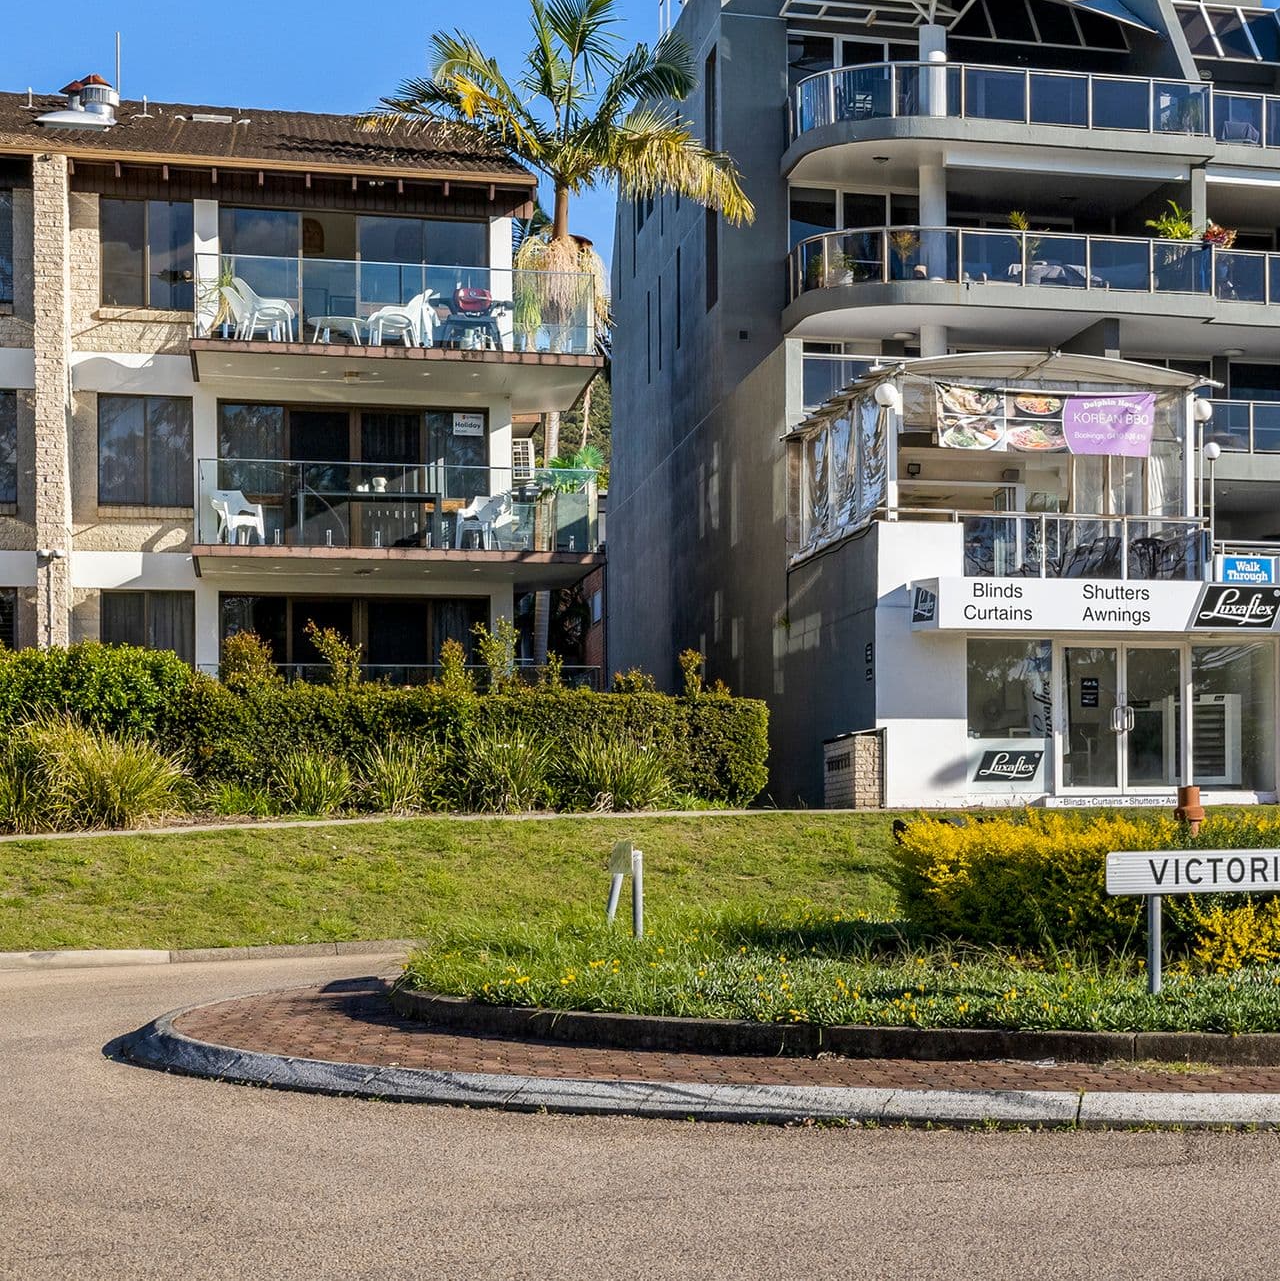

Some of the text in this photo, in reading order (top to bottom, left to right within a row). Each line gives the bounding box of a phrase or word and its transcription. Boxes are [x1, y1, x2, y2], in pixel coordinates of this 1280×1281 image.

[1073, 412, 1122, 424] KOREAN
[1235, 561, 1261, 572] Walk
[1227, 570, 1268, 583] Through
[972, 583, 1023, 599] Blinds
[1082, 585, 1150, 601] Shutters
[963, 604, 1033, 621] Curtains
[1200, 588, 1275, 626] Luxaflex
[1082, 606, 1151, 625] Awnings
[979, 752, 1035, 779] Luxaflex
[1063, 797, 1086, 805] Blinds
[1092, 797, 1123, 805] Curtains
[1129, 797, 1160, 805] Shutters
